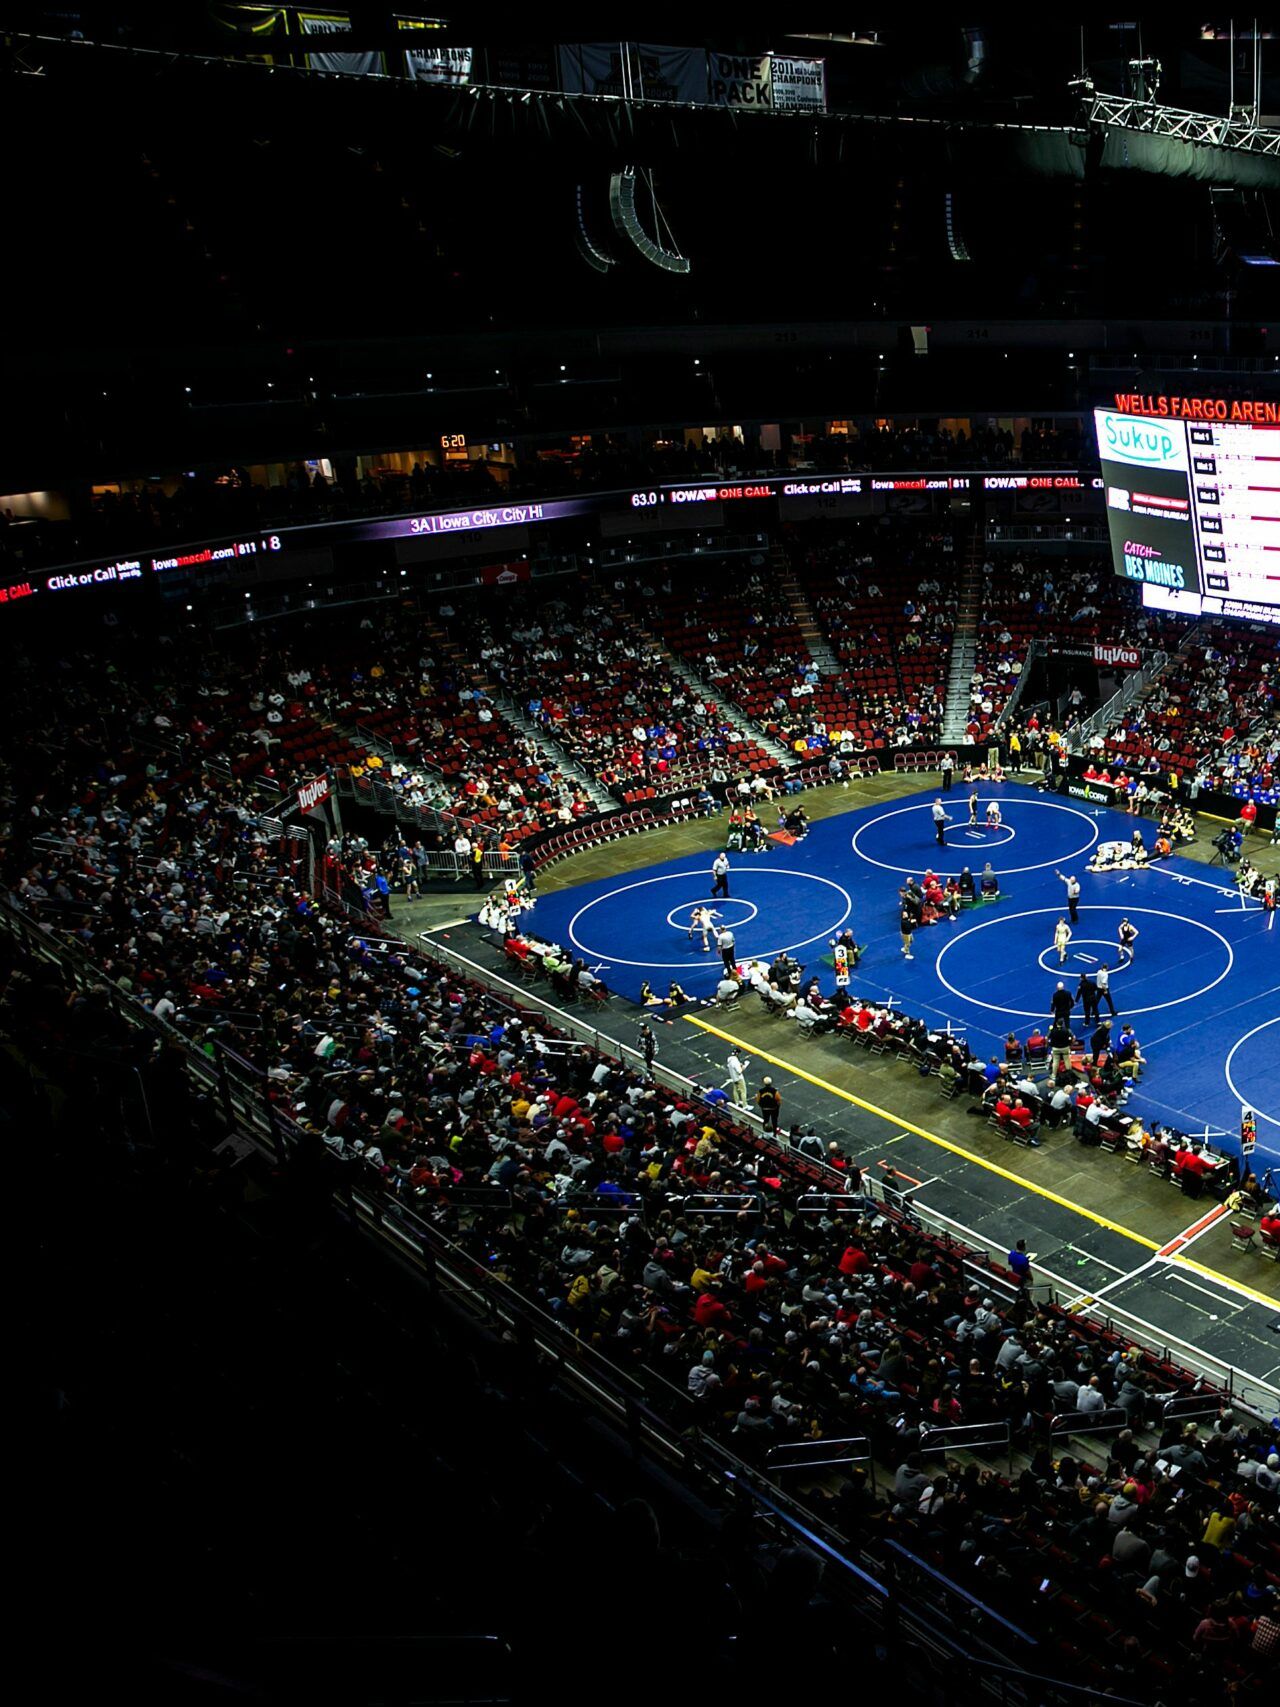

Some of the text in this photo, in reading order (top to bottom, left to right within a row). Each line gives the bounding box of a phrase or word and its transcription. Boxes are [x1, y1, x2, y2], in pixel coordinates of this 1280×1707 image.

[411, 48, 471, 62] CHAMPIONS
[720, 59, 762, 80] ONE
[771, 62, 794, 75] 2011
[772, 75, 822, 86] CHAMPIONS
[715, 81, 771, 104] PACK
[1115, 394, 1168, 415] WELLS
[1171, 397, 1226, 419] FARGO
[441, 434, 466, 448] 6:20
[1105, 416, 1174, 460] Sukup
[784, 482, 840, 495] Click or Call
[953, 478, 970, 488] 811
[984, 478, 1017, 488] IOWA
[1030, 478, 1052, 487] ONE
[632, 492, 657, 506] 63.0
[671, 490, 706, 502] IOWA
[719, 488, 743, 499] ONE
[410, 519, 431, 533] 3A
[439, 515, 470, 529] Iowa
[503, 508, 527, 523] City
[529, 505, 543, 518] Hi
[238, 542, 256, 555] 811
[270, 536, 281, 550] 8
[1124, 541, 1153, 557] CATCH
[48, 567, 116, 590] Click or Call
[1124, 556, 1184, 588] DES MOINES
[1094, 645, 1137, 665] HyVee
[298, 780, 328, 808] HyVee
[1069, 786, 1108, 801] IOWA CORN
[1244, 1111, 1252, 1120] 4
